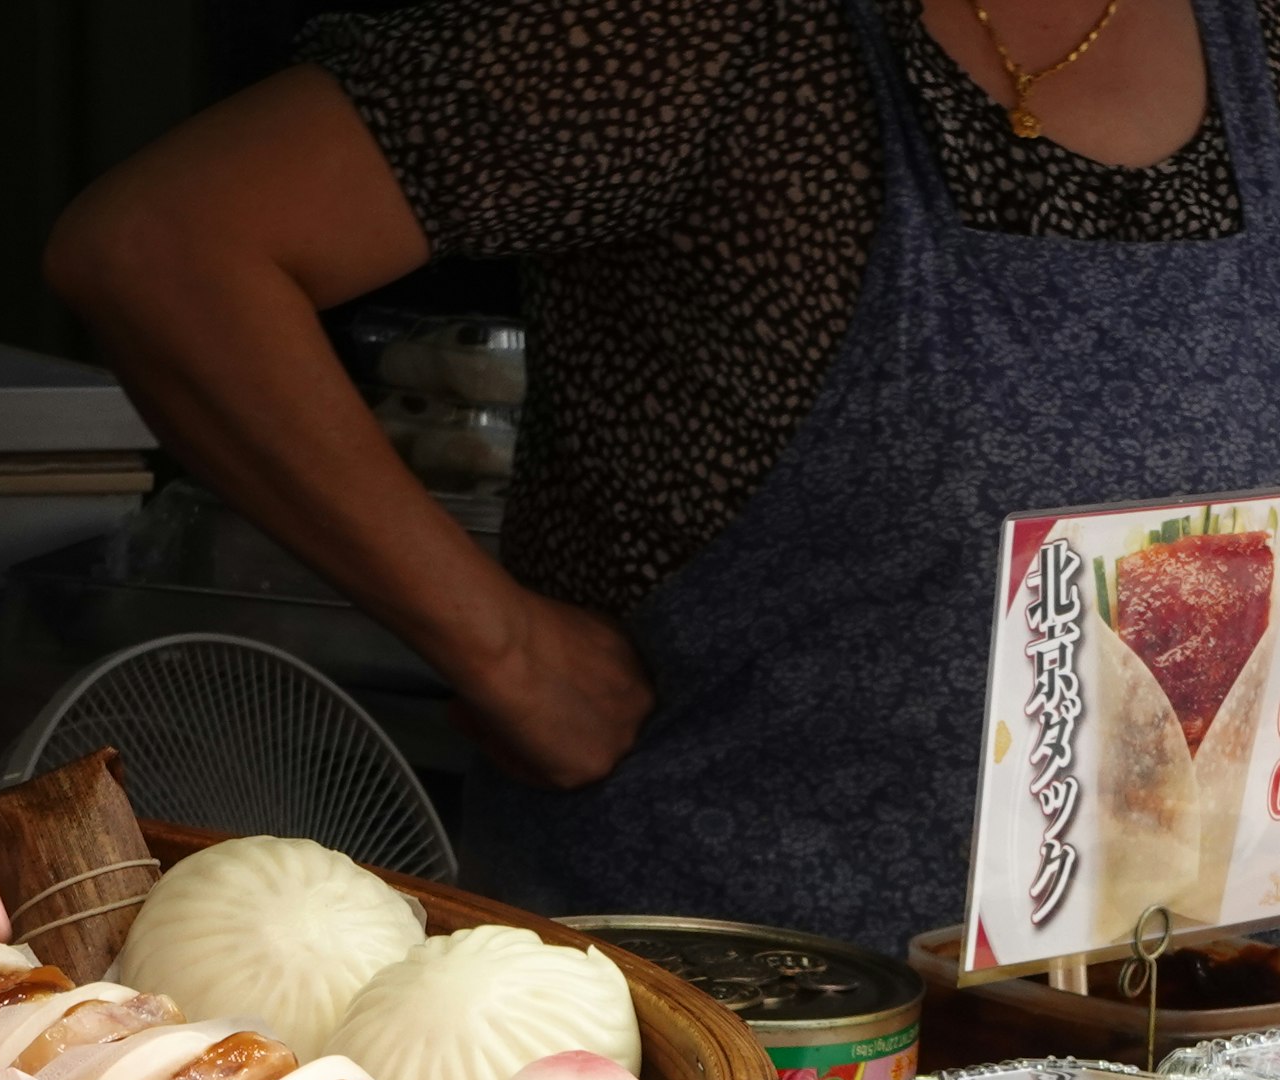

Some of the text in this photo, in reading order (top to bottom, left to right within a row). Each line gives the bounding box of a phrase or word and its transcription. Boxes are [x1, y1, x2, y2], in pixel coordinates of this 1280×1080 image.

[1026, 538, 1081, 926] 北京ダック
